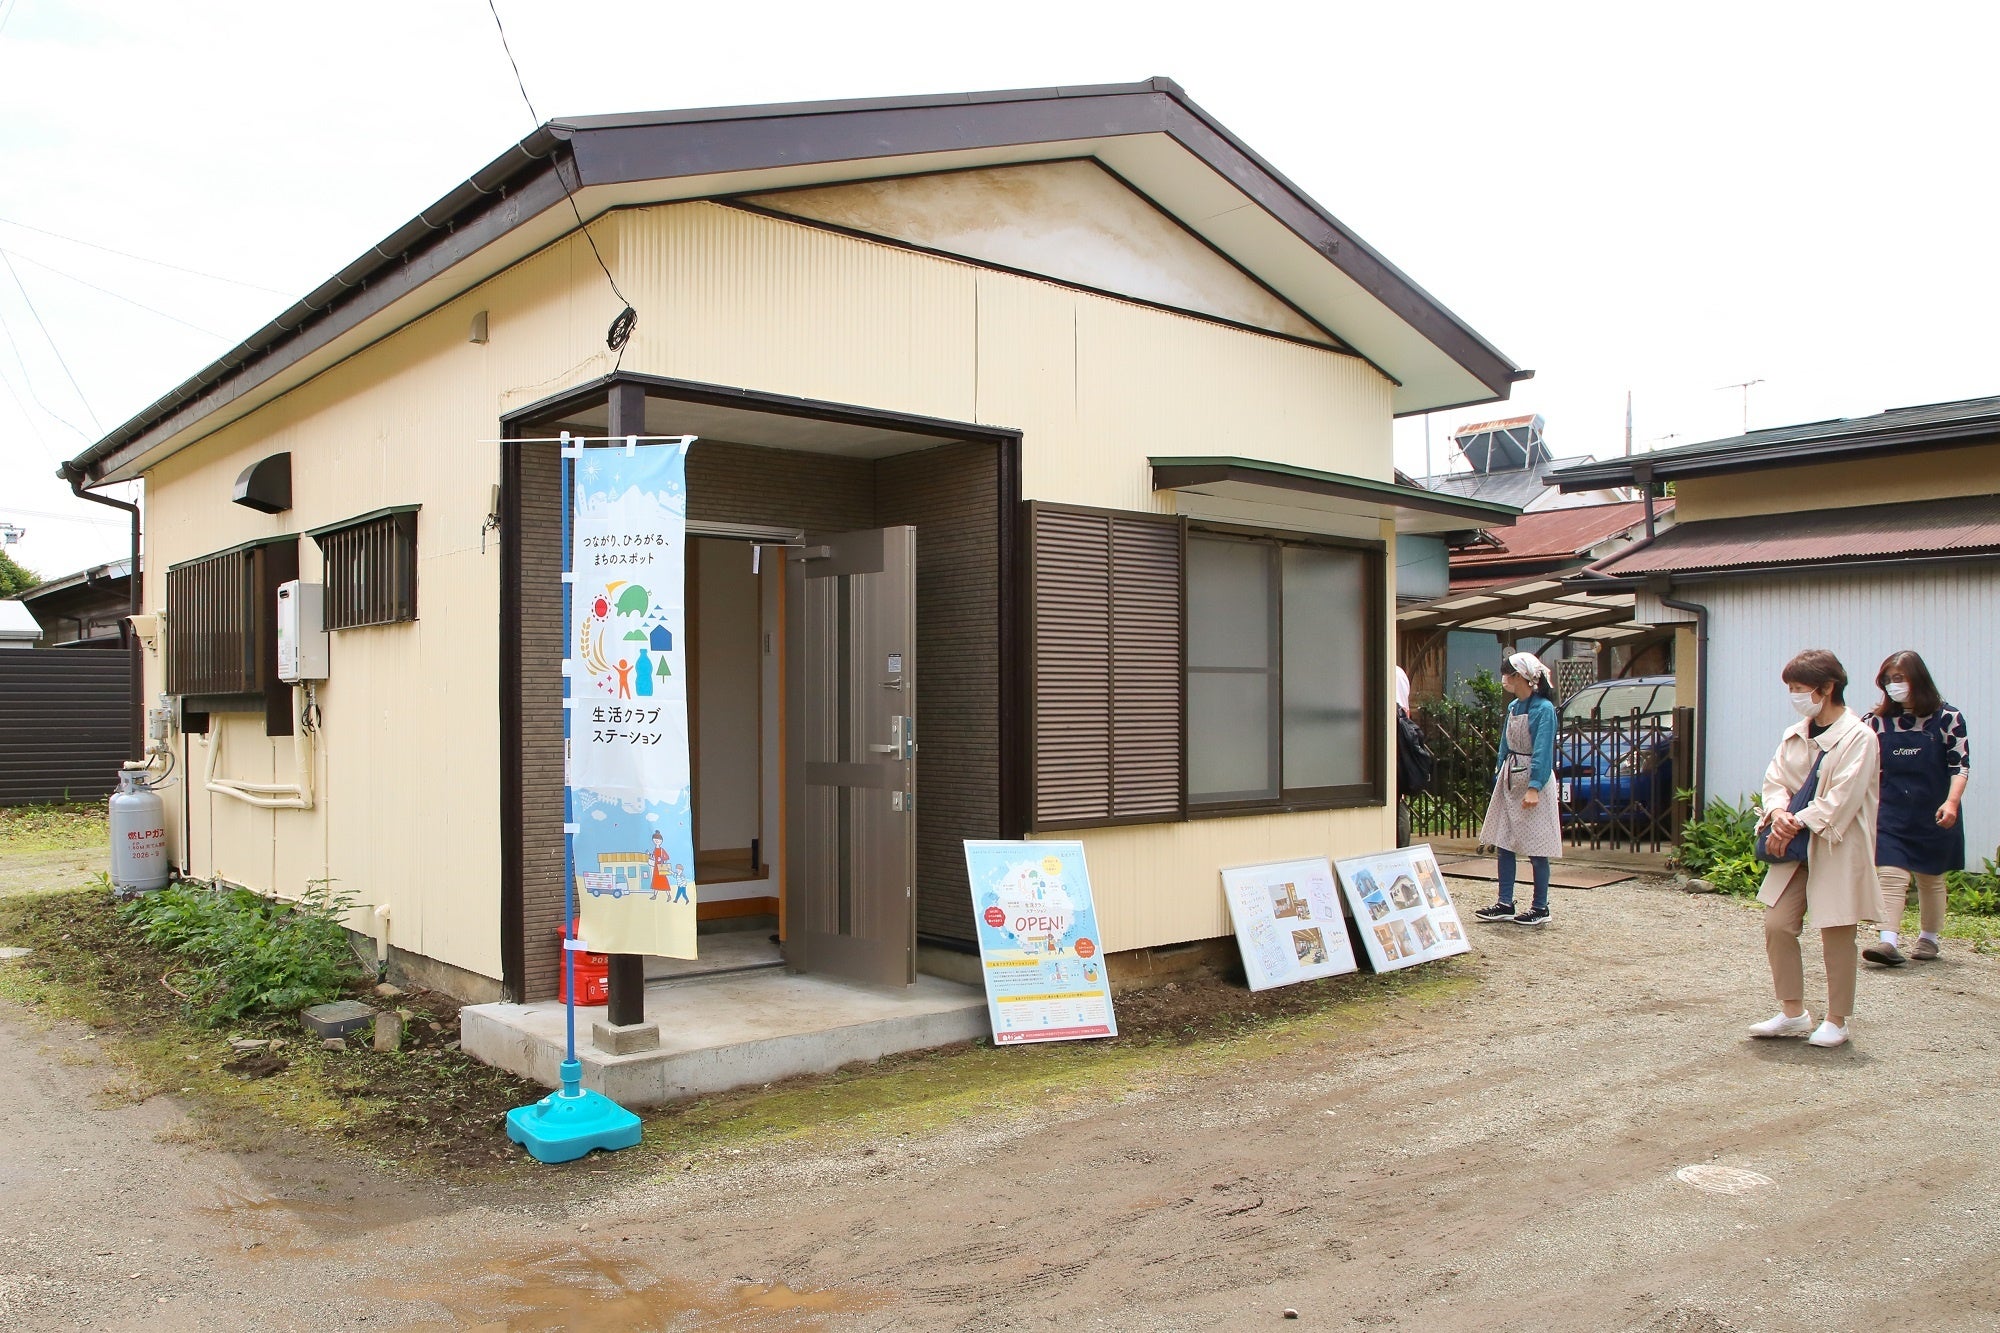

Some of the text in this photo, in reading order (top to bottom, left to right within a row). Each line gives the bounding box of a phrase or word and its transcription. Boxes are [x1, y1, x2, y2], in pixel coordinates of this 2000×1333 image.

[583, 533, 670, 547] つながり、ひろがる、
[593, 553, 654, 566] まちのスポット
[592, 706, 662, 725] 生活クラブ
[592, 730, 662, 745] ステーション
[1015, 915, 1064, 932] OPEN!
